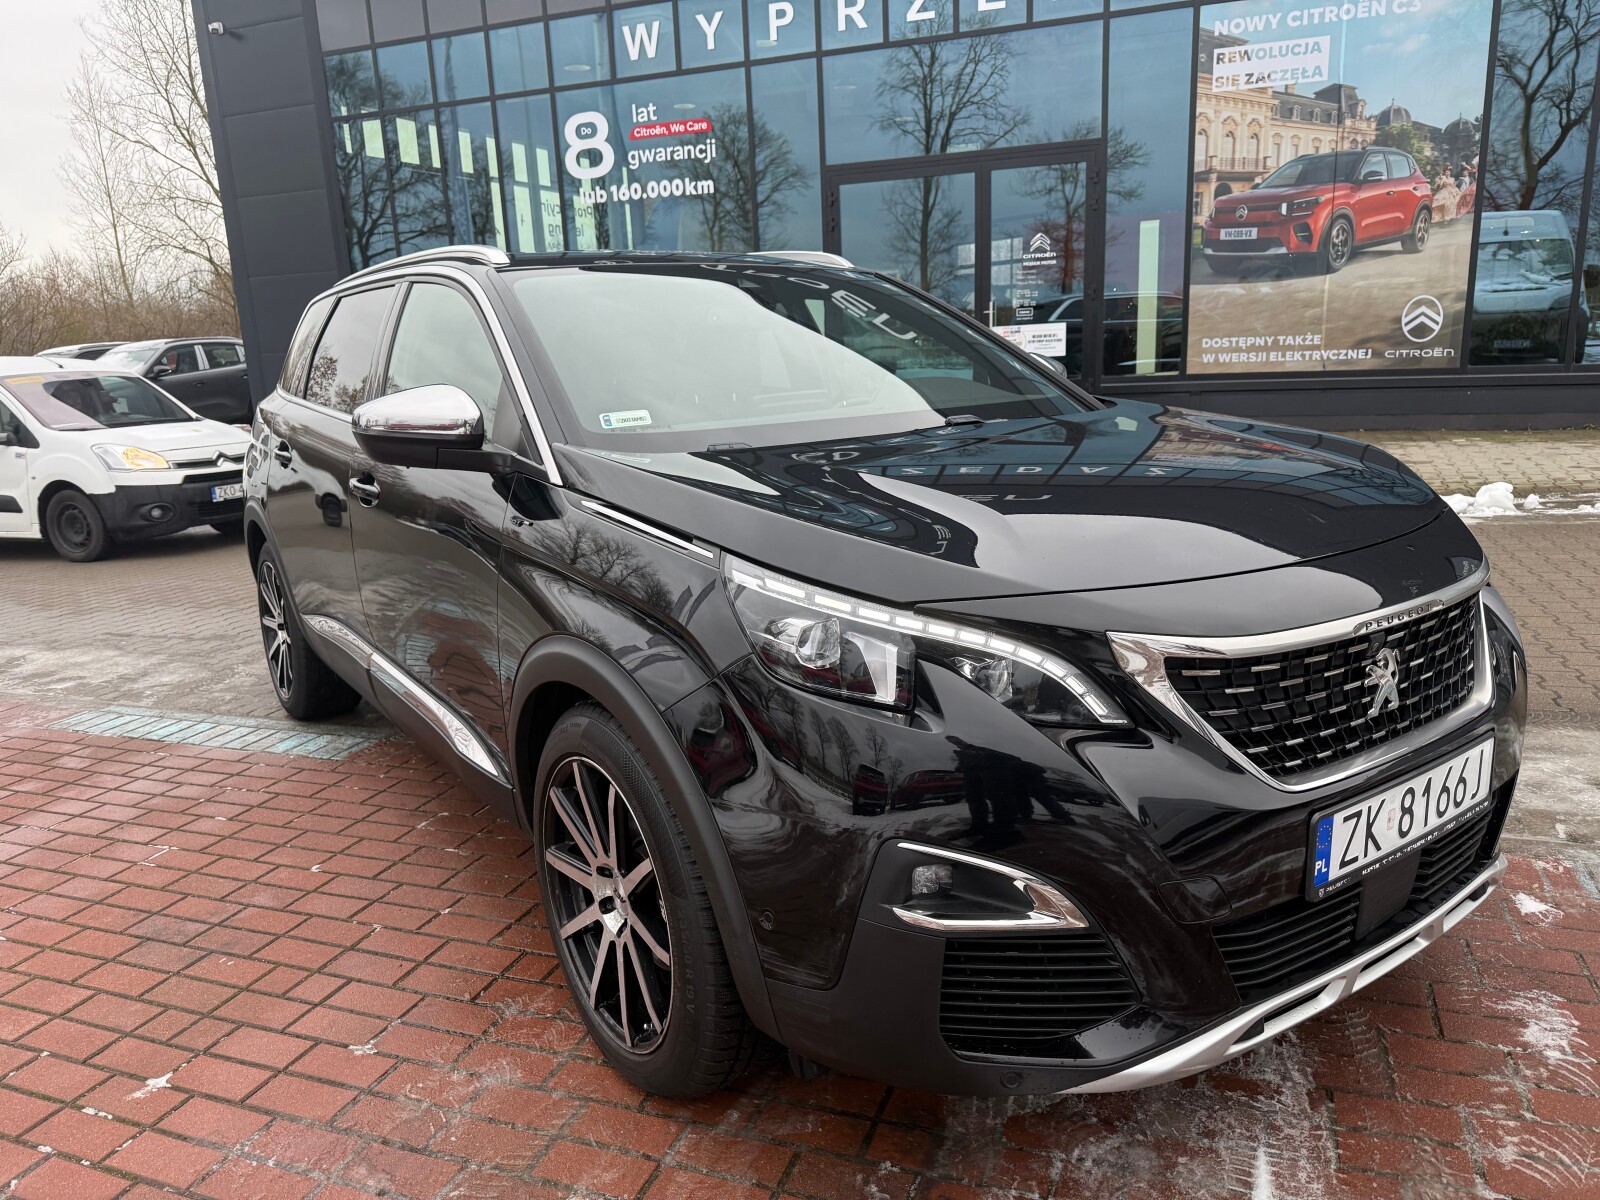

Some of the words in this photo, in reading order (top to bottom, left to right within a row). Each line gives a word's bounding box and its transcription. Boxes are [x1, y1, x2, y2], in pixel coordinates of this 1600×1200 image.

[1214, 12, 1283, 36] NOWY
[1286, 0, 1387, 27] CITROËN
[1392, 0, 1422, 14] C3
[1216, 41, 1322, 65] REWOLUCJA
[1215, 74, 1241, 90] SIĘ
[1244, 65, 1324, 85] ZACZĘŁA
[631, 103, 657, 123] lat
[580, 127, 592, 136] Do
[633, 125, 668, 138] Citroën,
[670, 123, 685, 133] We
[686, 121, 708, 131] Care
[564, 111, 615, 180] 8
[627, 138, 716, 170] gwarancji
[579, 186, 608, 205] lub
[1202, 336, 1275, 349] DOSTĘPNY
[1277, 332, 1322, 346] TAKŻE
[1202, 353, 1217, 363] W
[1218, 351, 1267, 363] WERSJI
[1269, 348, 1372, 362] ELEKTRYCZNEJ
[1384, 347, 1455, 359] CITROËN
[1365, 603, 1433, 631] PEUGEOT
[1338, 798, 1386, 871] ZK
[1398, 748, 1485, 839] 8166J
[1314, 860, 1328, 876] PL
